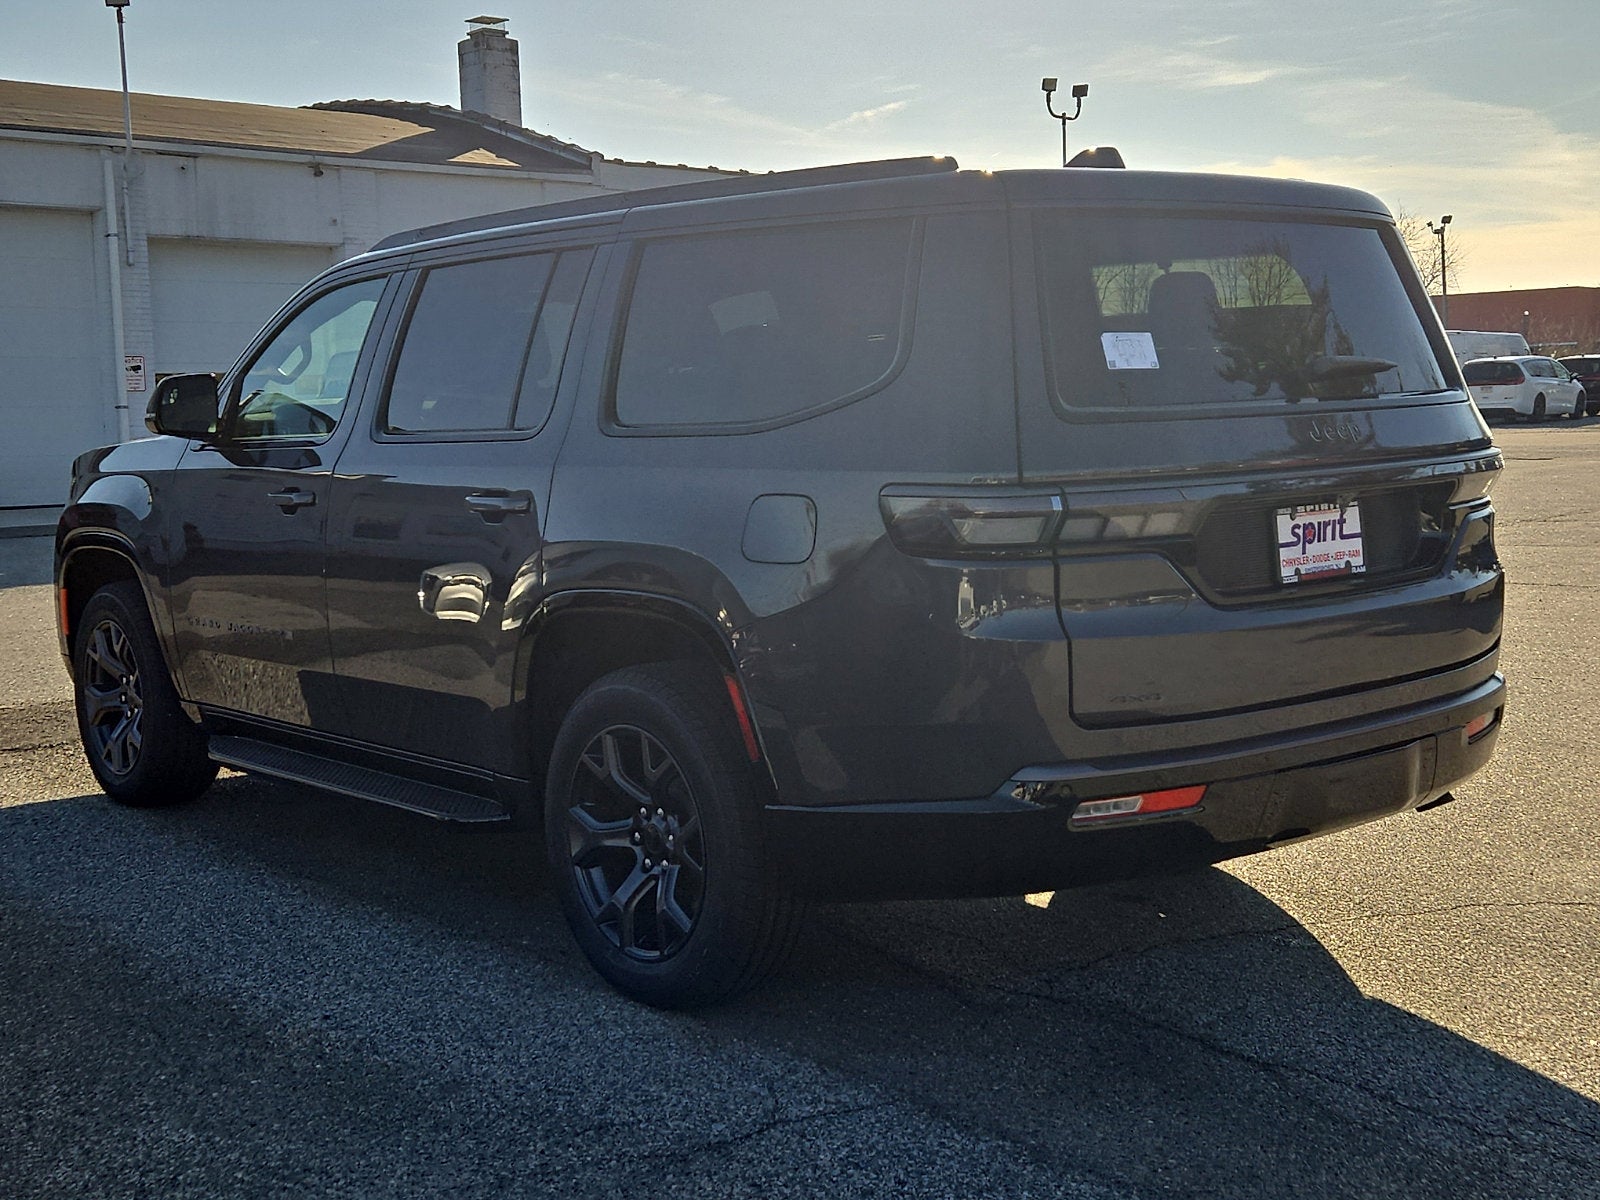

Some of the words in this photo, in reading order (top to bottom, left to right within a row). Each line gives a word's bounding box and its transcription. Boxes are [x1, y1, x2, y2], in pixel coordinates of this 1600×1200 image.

[1309, 420, 1361, 442] Jeep
[1281, 555, 1310, 568] CHRYSLER
[1312, 552, 1331, 564] DODGE
[1333, 550, 1346, 561] JEEP
[1348, 549, 1361, 558] RAM
[1352, 565, 1366, 574] RAM
